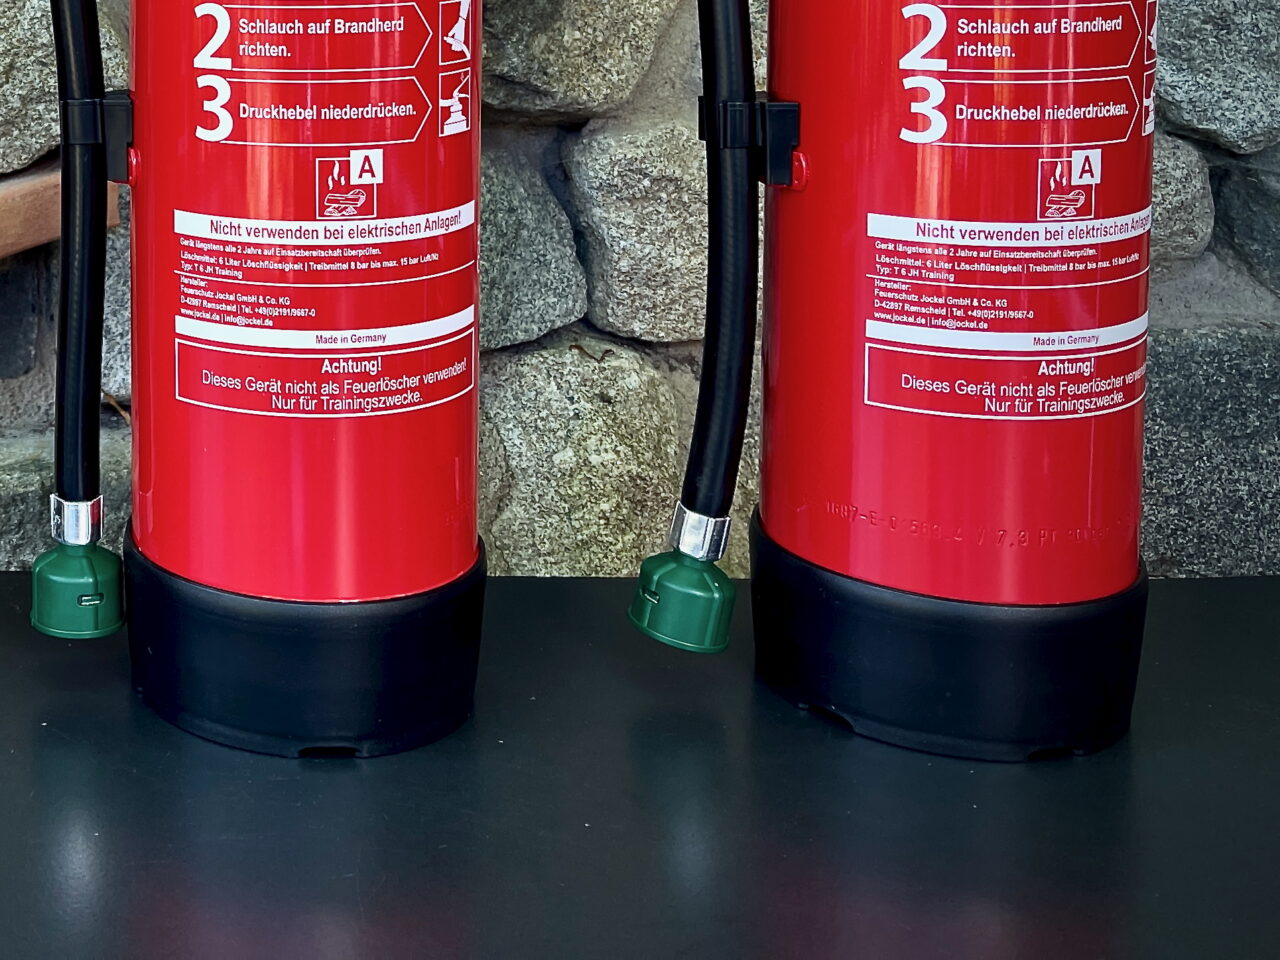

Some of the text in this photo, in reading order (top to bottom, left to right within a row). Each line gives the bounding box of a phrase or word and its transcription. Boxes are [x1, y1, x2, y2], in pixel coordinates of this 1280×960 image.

[239, 17, 403, 34] Schlauch auf Brandherd
[958, 16, 1122, 34] Schlauch auf Brandherd
[194, 3, 233, 70] 2
[899, 3, 947, 71] 2
[240, 41, 290, 56] richten.
[958, 42, 1015, 57] richten.
[196, 75, 235, 143] 3
[240, 102, 416, 119] Druckhebel niederdrücken.
[900, 76, 949, 146] 3
[956, 102, 1128, 120] Druckhebel niederdrücken.
[358, 155, 376, 178] A
[1079, 155, 1094, 179] A
[211, 210, 460, 239] Nicht verwenden bei elektrischen Anlagen!
[917, 222, 954, 239] Nicht
[960, 228, 1039, 241] verwenden
[1045, 226, 1063, 240] bei
[1068, 222, 1128, 240] elektrischen
[900, 267, 907, 276] 6
[921, 270, 954, 282] Training
[875, 289, 918, 301] Feuerschutz
[920, 295, 944, 303] Jockel
[947, 297, 970, 305] GmbH
[973, 298, 978, 306] &
[996, 299, 1007, 307] KG
[316, 335, 338, 344] Made
[351, 334, 386, 343] Germany
[1033, 337, 1055, 345] Made
[1067, 336, 1099, 344] Germany
[322, 357, 381, 375] Achtung!
[1038, 358, 1094, 376] Achtung!
[203, 358, 466, 394] Dieses Gerät nicht als Feuerlöscher verwenden!
[902, 374, 1124, 396] Dieses Gerät nicht als Feuerlöscher
[272, 390, 420, 412] Nur für Trainingszwecke.
[985, 387, 1124, 413] Nur für Trainingszwecke.
